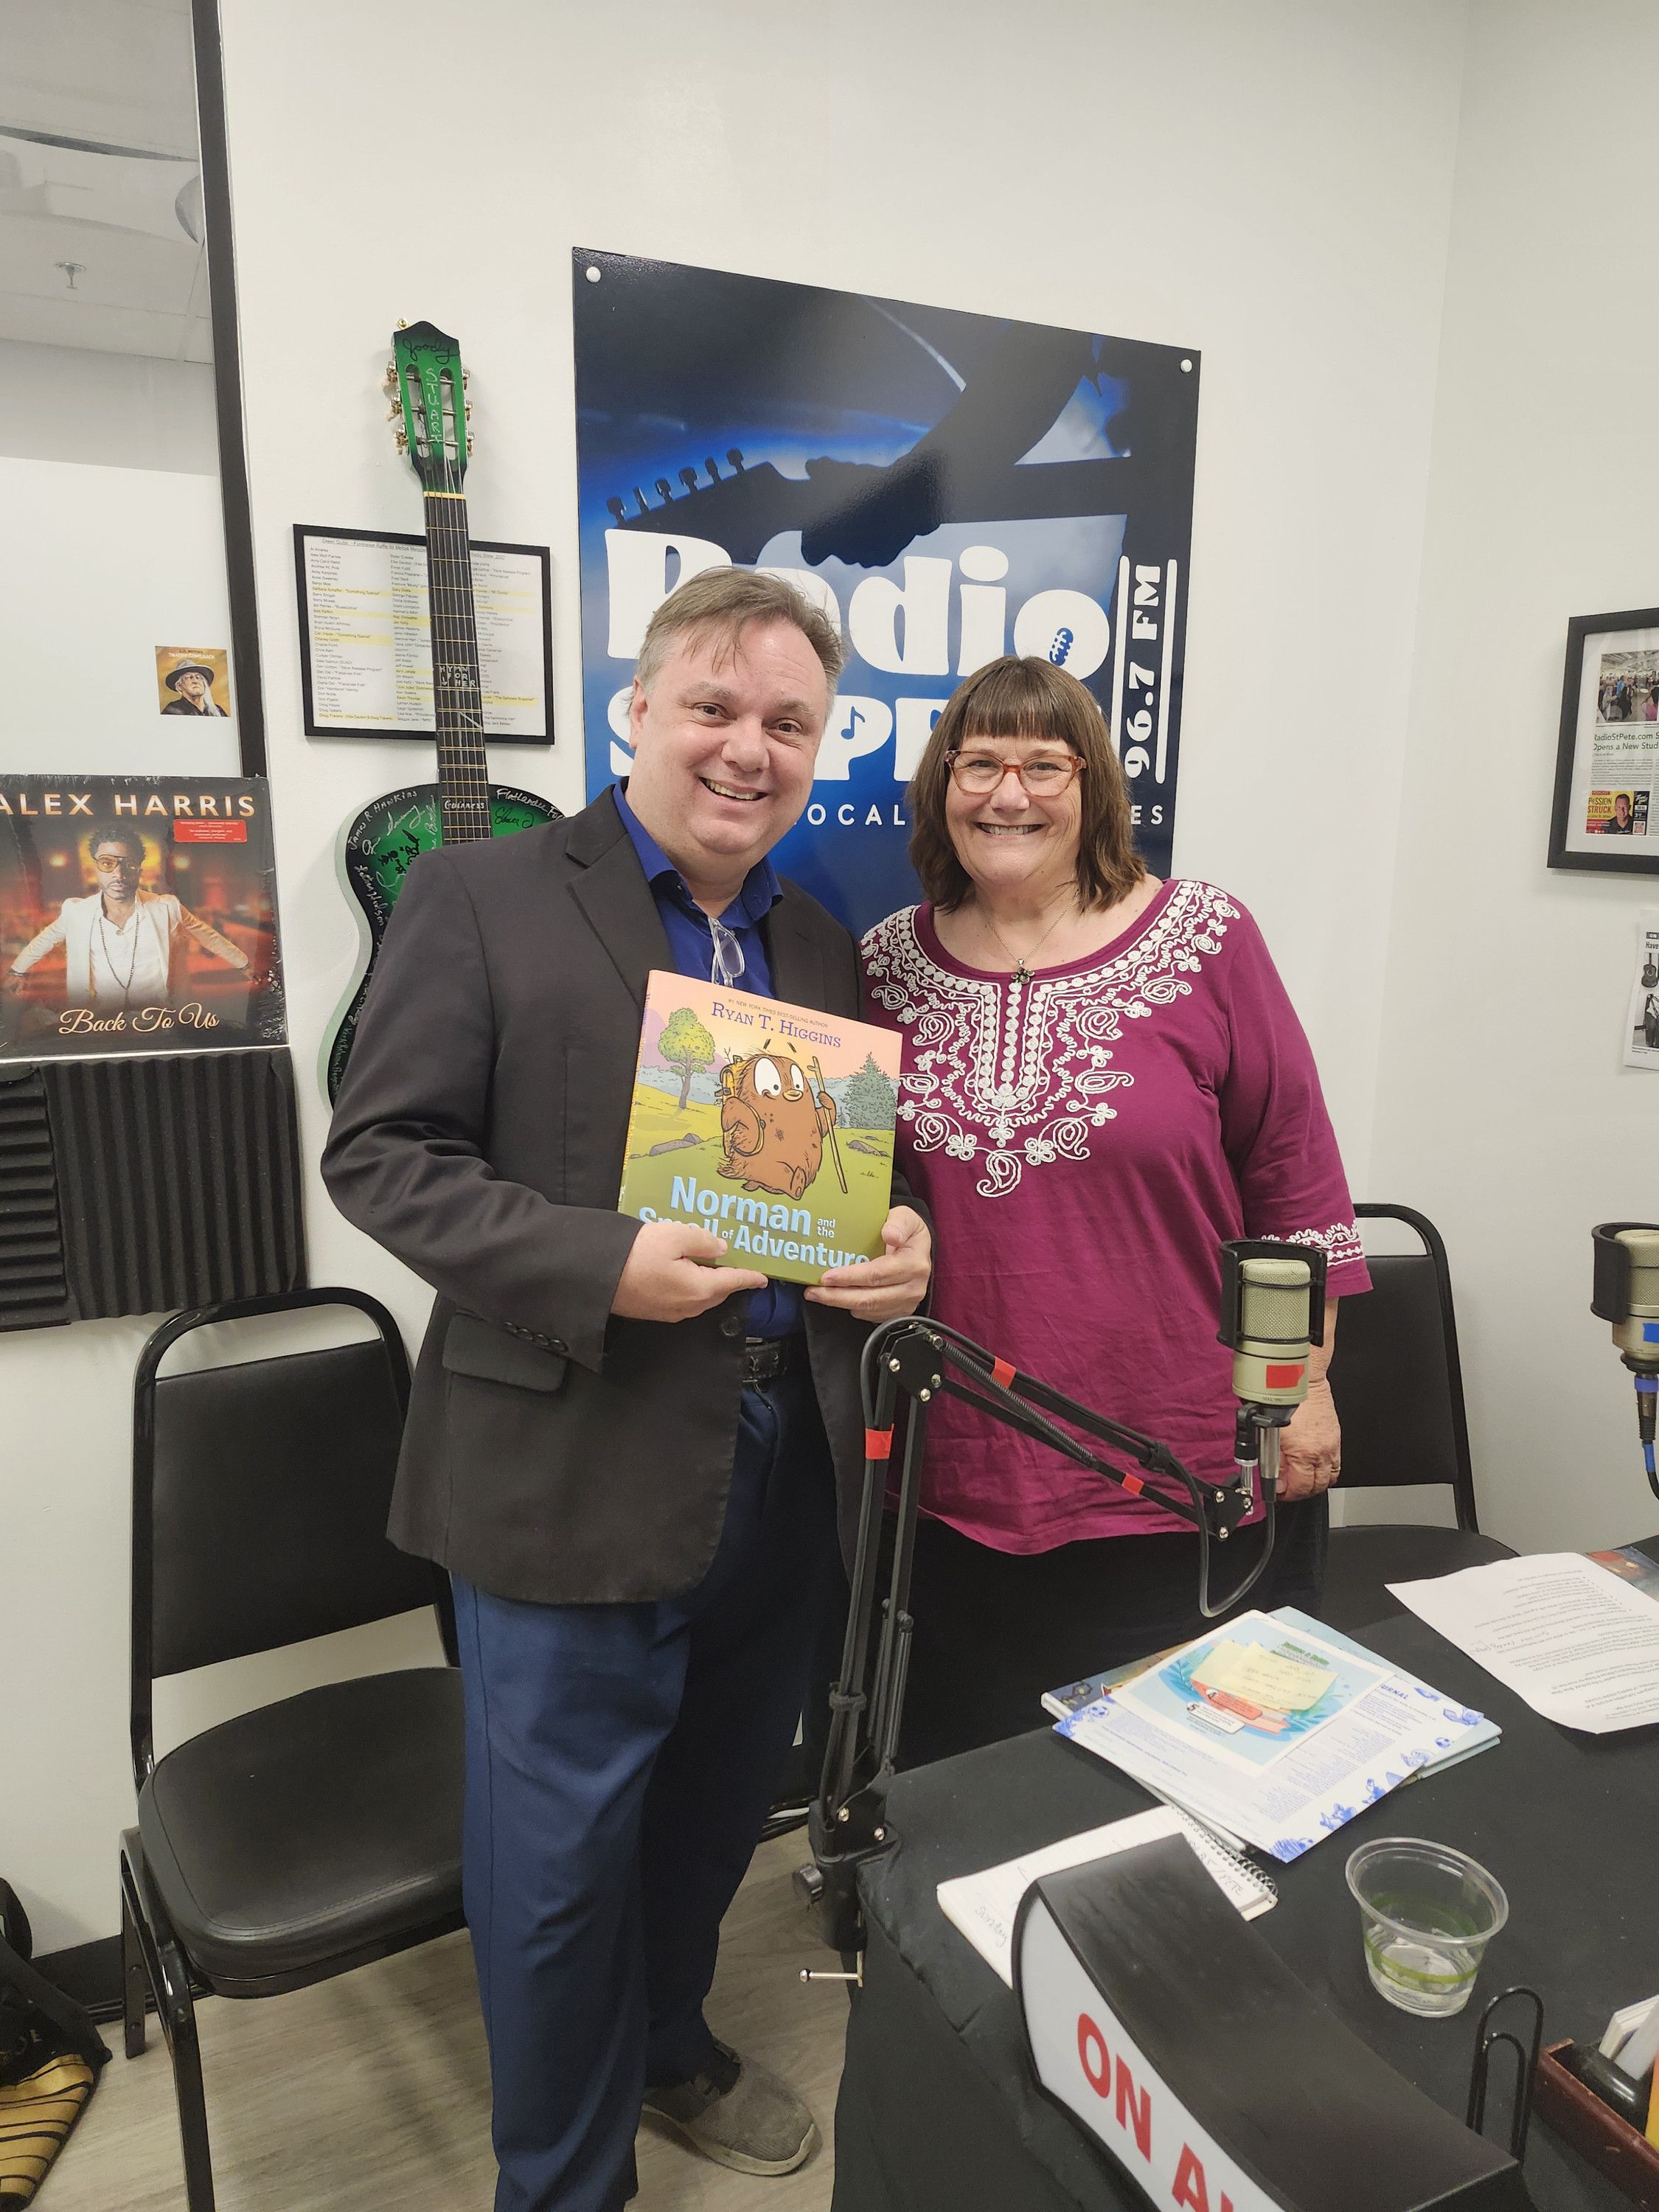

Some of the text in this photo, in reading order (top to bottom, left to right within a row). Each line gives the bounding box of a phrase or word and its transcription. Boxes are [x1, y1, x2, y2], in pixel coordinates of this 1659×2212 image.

[605, 529, 1110, 681] Rdio
[1132, 564, 1161, 640] FM
[455, 679, 476, 687] HER
[1124, 661, 1155, 779] 96.7
[0, 793, 256, 817] ALEX HARRIS
[795, 804, 906, 826] OCAL
[58, 1002, 220, 1034] Back To Us
[736, 1001, 747, 1009] NEW
[762, 1007, 776, 1015] TIMES
[810, 1020, 828, 1028] AUTHOR
[758, 1014, 774, 1032] T.
[670, 1175, 811, 1237] Norman
[721, 1229, 734, 1240] of
[817, 1217, 835, 1228] and
[817, 1227, 835, 1238] the
[1077, 2013, 1151, 2164] ON
